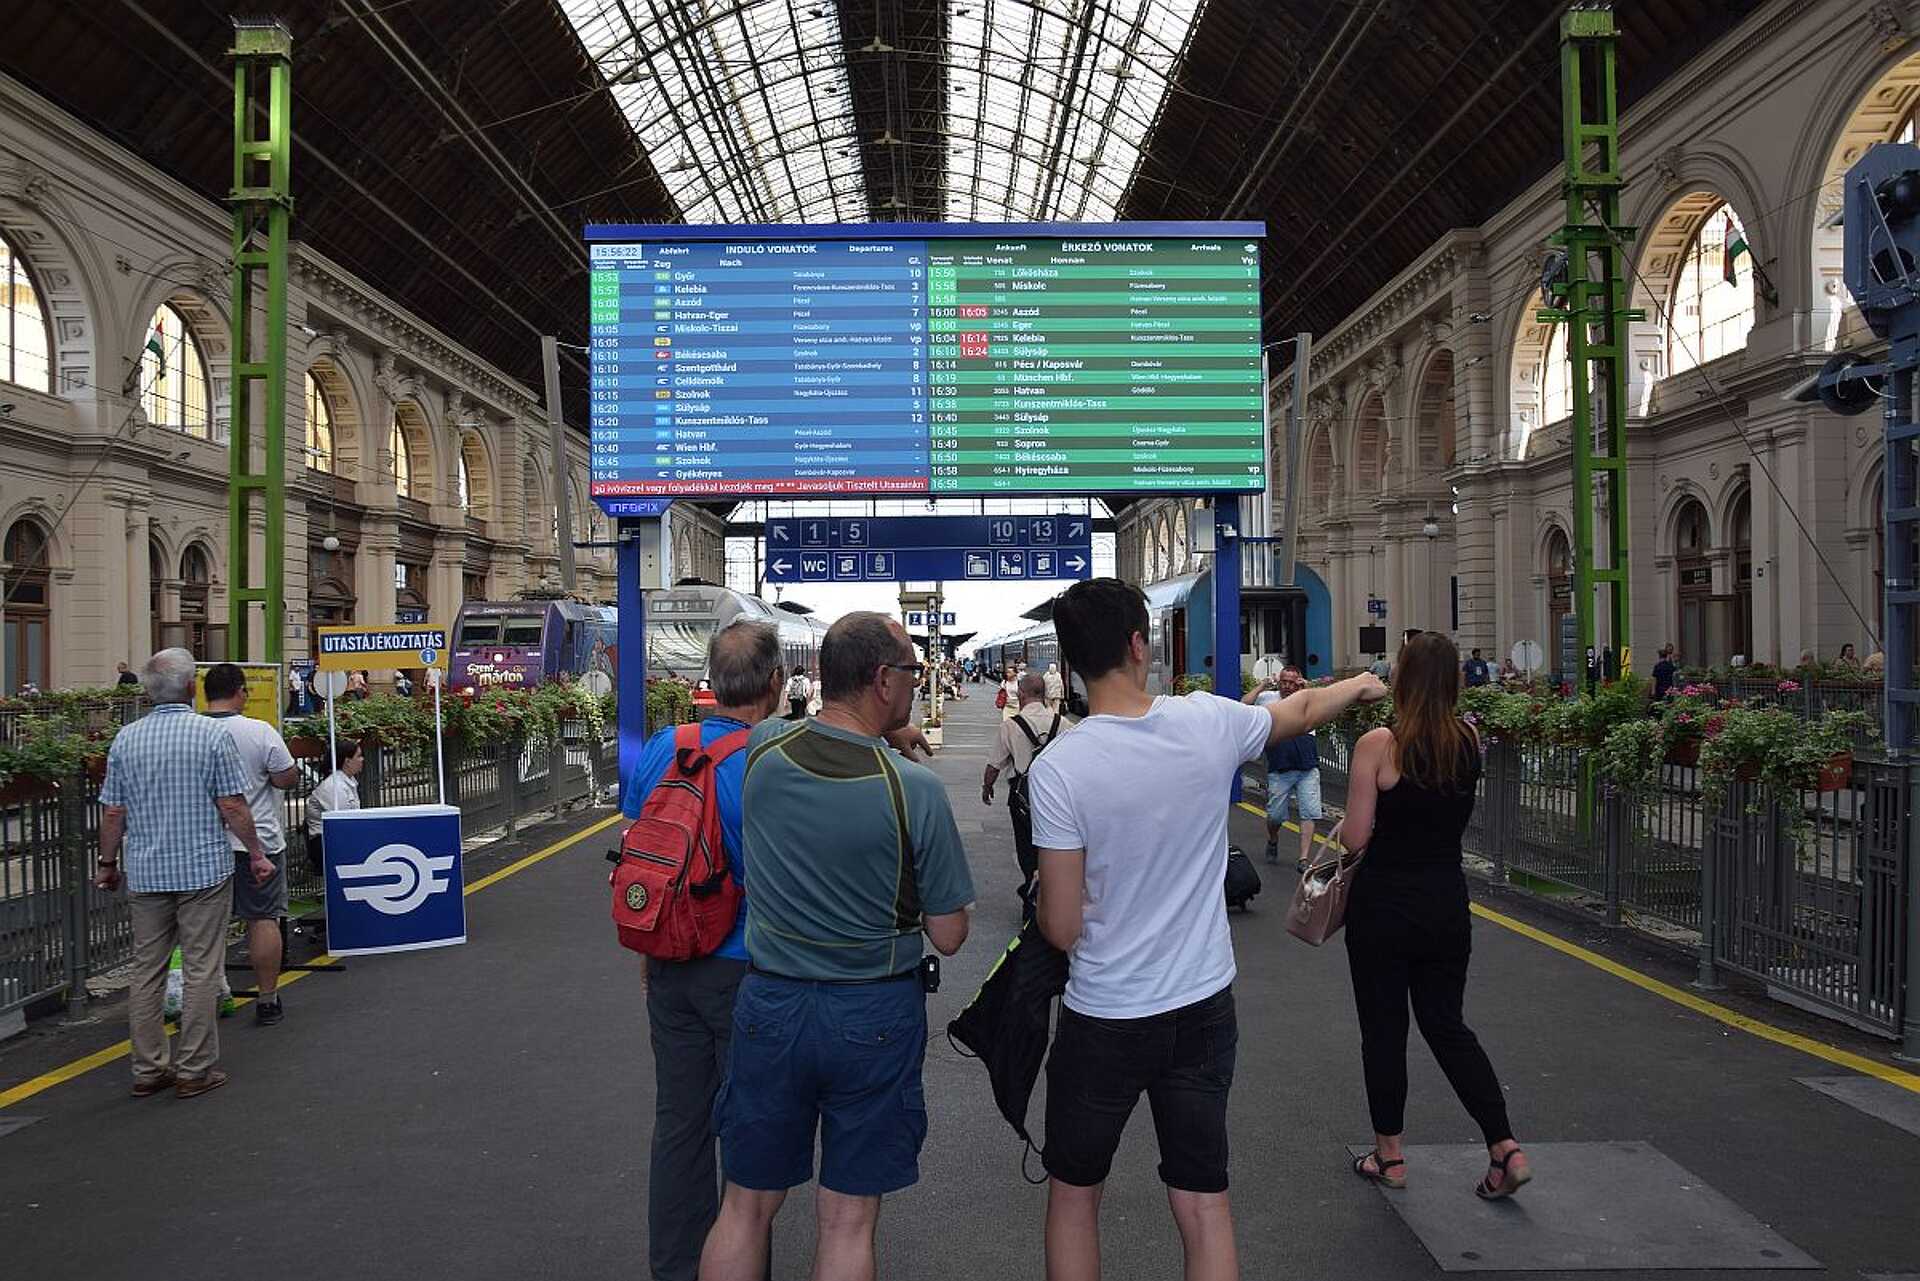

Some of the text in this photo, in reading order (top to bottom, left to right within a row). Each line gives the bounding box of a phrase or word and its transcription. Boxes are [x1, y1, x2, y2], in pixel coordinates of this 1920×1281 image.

[725, 243, 818, 255] INDULÓ VONATOK
[848, 245, 895, 254] Departures
[1061, 240, 1153, 252] ÉRKEZŐ VONATOK
[658, 247, 690, 256] Abfahrt
[653, 260, 672, 270] Zug
[719, 258, 743, 268] Nach
[986, 256, 1015, 265] Vonat
[1050, 256, 1086, 265] Honnan
[674, 272, 696, 282] Győr
[909, 269, 921, 278] 10
[674, 284, 707, 294] Kelebia
[911, 282, 919, 290] 3
[1012, 281, 1047, 290] Miskolc
[592, 299, 619, 308] 16:00
[674, 297, 702, 307] Aszód
[911, 295, 920, 304] 7
[592, 312, 619, 321] 16:00
[674, 311, 730, 322] Hatvan-Eger
[911, 308, 920, 317] 7
[930, 308, 957, 317] 16:00
[960, 307, 988, 317] 16:05
[1012, 307, 1041, 317] Aszód
[592, 325, 619, 334] 16:05
[674, 323, 739, 333] Miskolc-Tiszai
[1012, 321, 1034, 331] Eger
[930, 334, 957, 343] 16:04
[960, 334, 988, 343] 16:14
[1012, 334, 1046, 343] Kelebia
[592, 339, 619, 348] 16:05
[592, 351, 619, 361] 16:10
[674, 350, 728, 360] Békéscsaba
[912, 347, 920, 356] 2
[930, 347, 957, 356] 16:10
[960, 347, 988, 356] 16:24
[674, 363, 738, 374] Szentgotthárd
[912, 361, 920, 369] 8
[930, 360, 957, 369] 16:14
[1013, 360, 1036, 369] Pécs
[1042, 359, 1084, 370] Kaposvár
[592, 365, 619, 374] 16:10
[912, 374, 920, 383] 8
[930, 374, 957, 383] 16:19
[1013, 373, 1054, 382] München
[1055, 373, 1075, 382] Hbf.
[592, 378, 619, 387] 16:10
[674, 390, 711, 399] Szolnok
[911, 387, 922, 396] 11
[930, 386, 957, 396] 16:30
[1013, 386, 1046, 395] Hatvan
[592, 391, 619, 401] 16:15
[592, 404, 619, 413] 16:20
[1013, 399, 1107, 409] Kunszentmiklós-Tass
[592, 417, 619, 426] 16:20
[675, 416, 769, 426] Kunszentmiklós-Tass
[911, 414, 923, 423] 12
[931, 413, 958, 422] 16:40
[1013, 412, 1049, 423] Sülysáp
[675, 430, 707, 439] Hatvan
[931, 426, 958, 436] 16:45
[1014, 426, 1050, 435] Szolnok
[675, 443, 698, 452] Wien
[931, 439, 958, 448] 16:49
[1014, 440, 1047, 449] Sopron
[592, 444, 619, 453] 16:40
[592, 457, 619, 466] 16:45
[675, 456, 712, 465] Szolnok
[1015, 452, 1067, 462] Békéscsaba
[592, 470, 619, 480] 16:45
[675, 469, 723, 480] Gyékényes
[1015, 465, 1070, 476] Nyíregyháza
[645, 484, 667, 495] vagy
[754, 483, 774, 493] meg
[797, 481, 845, 492] Javasoljuk
[846, 480, 878, 490] Tisztelt
[809, 522, 817, 540] 1
[848, 522, 861, 540] 5
[992, 520, 1014, 538] 10
[1032, 520, 1053, 537] 13
[802, 559, 827, 573] WC
[324, 631, 444, 652] UTASTÁJÉKOZTATÁS
[467, 662, 496, 676] Szent
